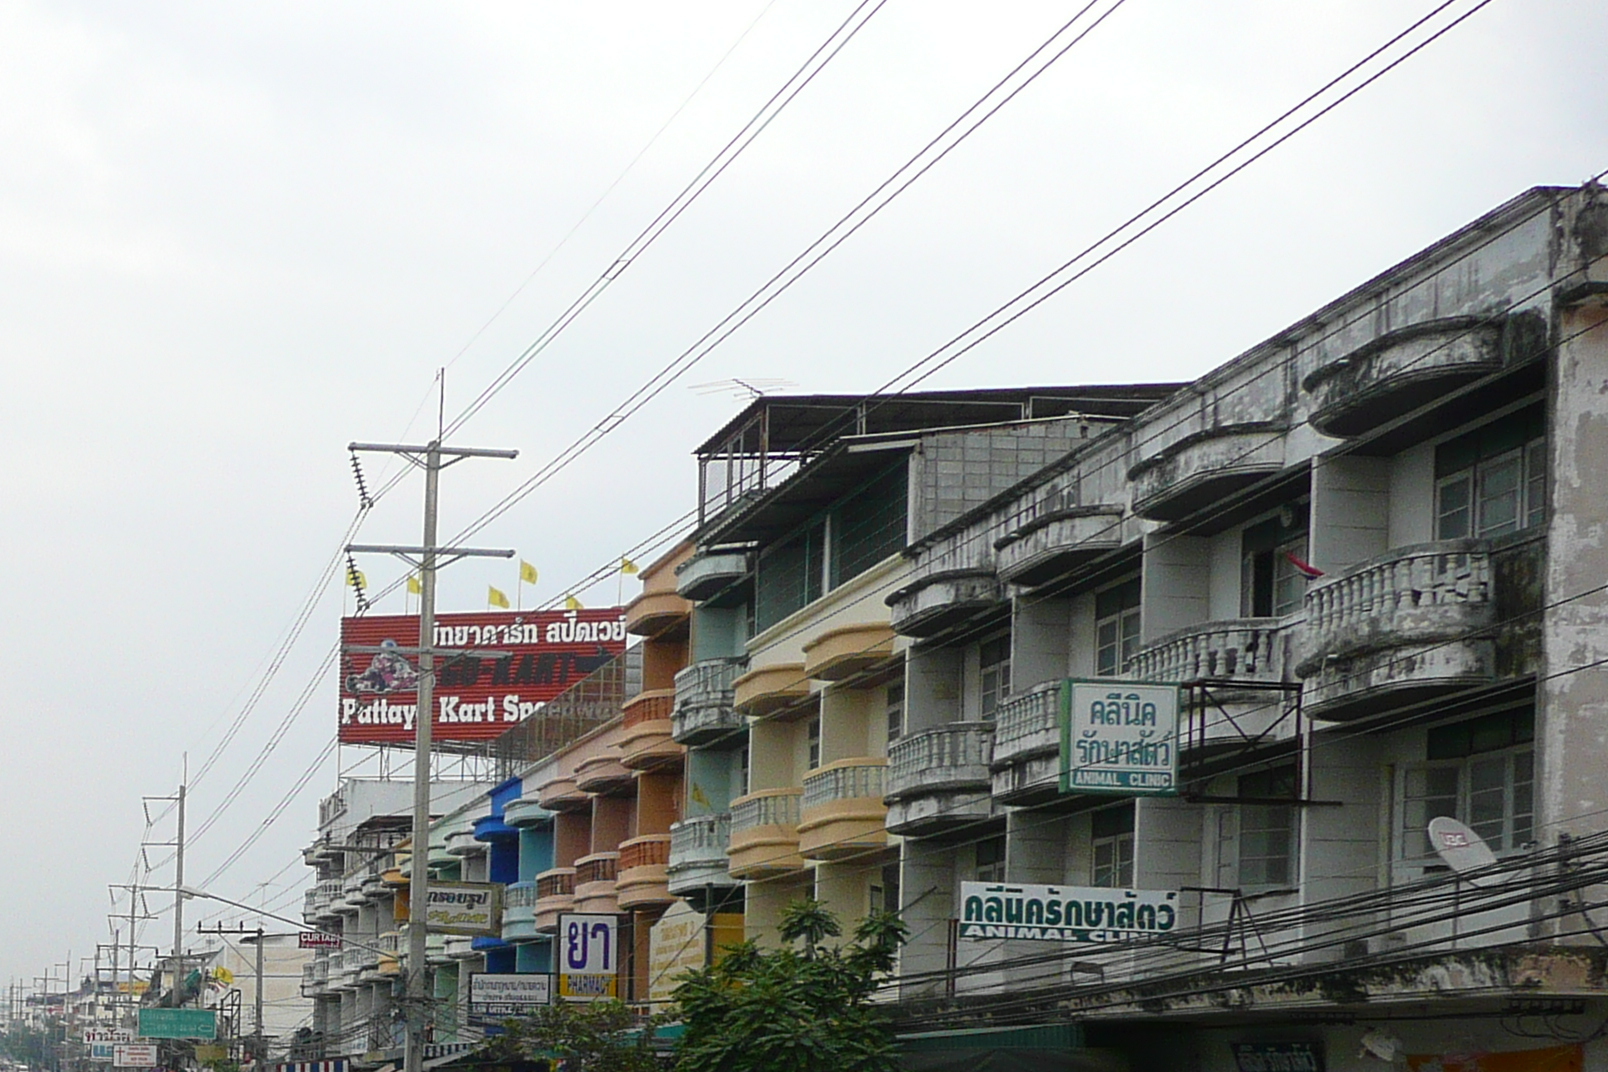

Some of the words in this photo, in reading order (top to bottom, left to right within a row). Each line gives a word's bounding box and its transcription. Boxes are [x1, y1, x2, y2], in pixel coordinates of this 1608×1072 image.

[341, 698, 419, 730] Pattay
[438, 696, 496, 723] Kart
[1075, 730, 1173, 766] รักษาสัตว์
[1075, 771, 1122, 786] ANIMAL
[1129, 773, 1170, 787] CLINIC
[568, 921, 610, 970] ยา
[964, 924, 1078, 941] ANIMAL
